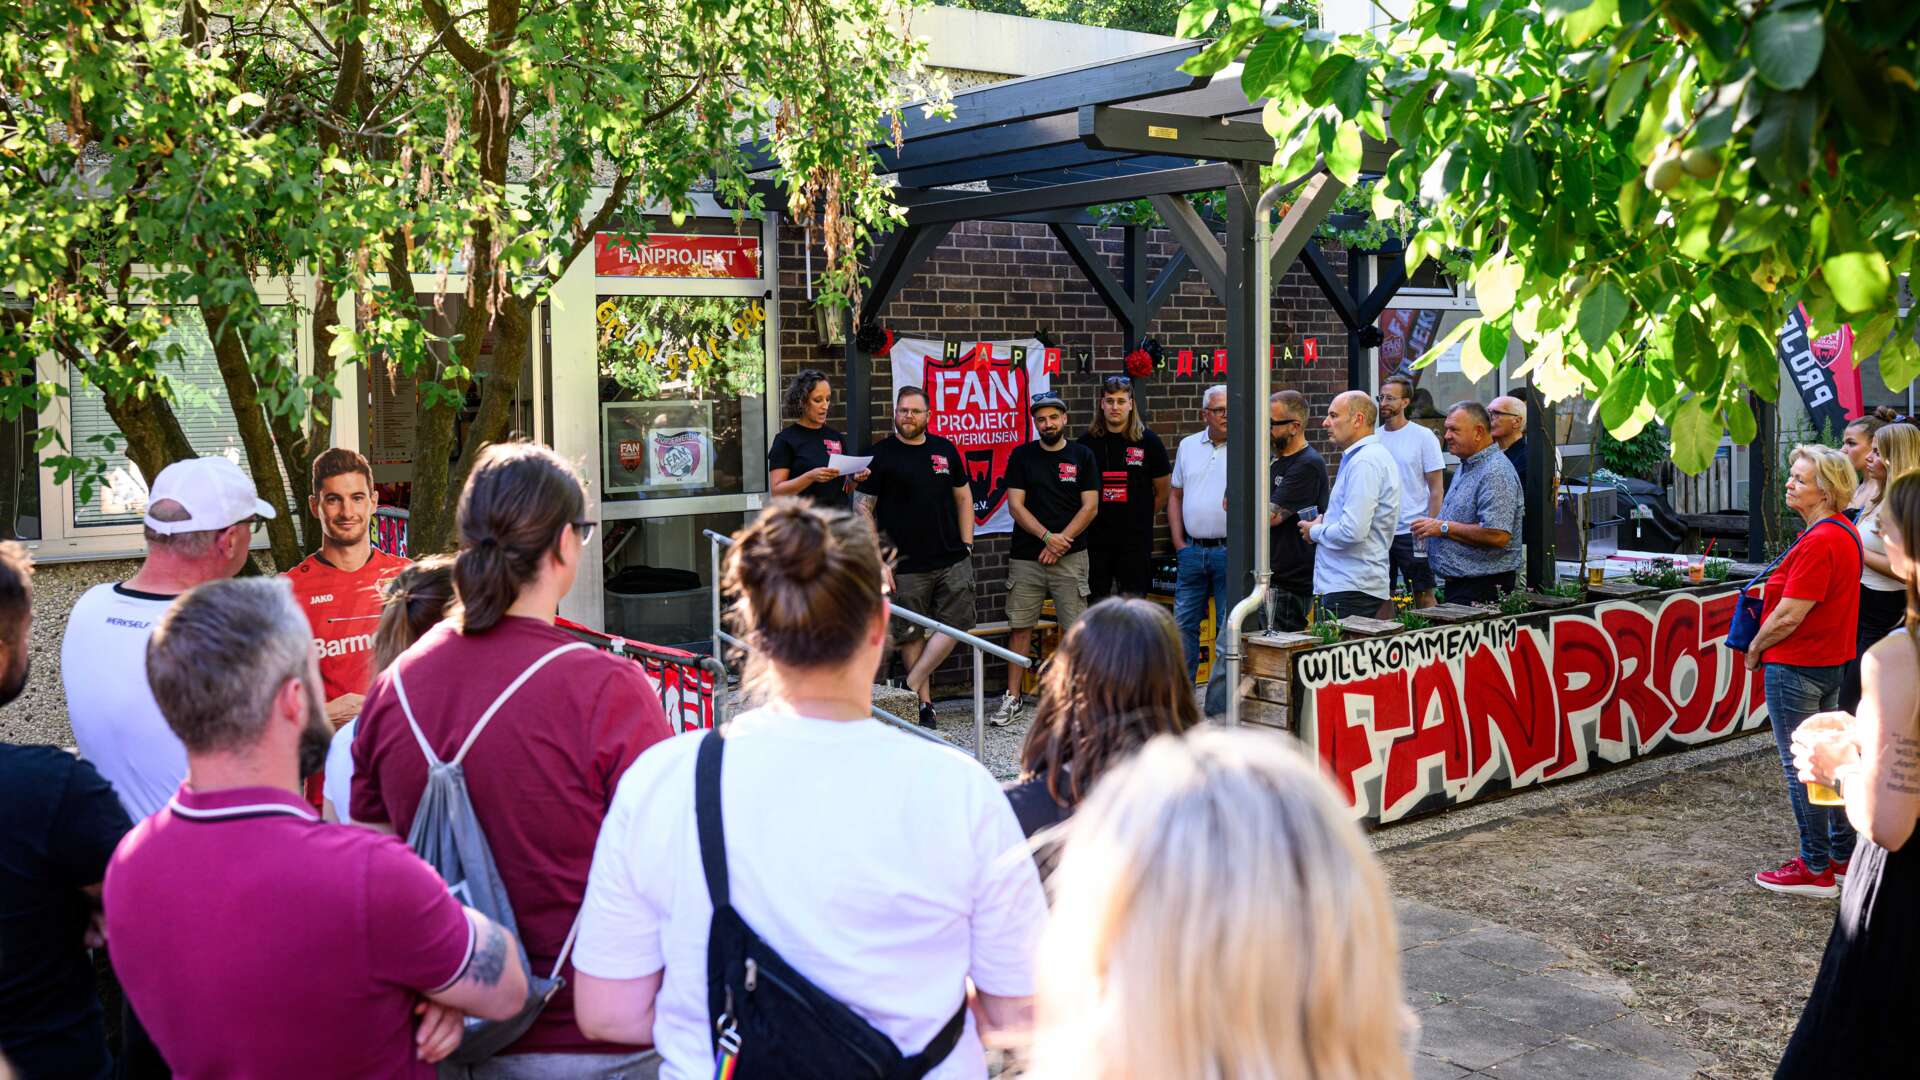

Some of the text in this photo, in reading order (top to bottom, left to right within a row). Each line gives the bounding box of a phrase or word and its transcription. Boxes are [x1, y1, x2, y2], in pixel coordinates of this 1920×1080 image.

[618, 247, 737, 267] FANPROJEKT
[725, 300, 767, 341] 1996
[946, 342, 1089, 369] HAPPY
[935, 370, 1019, 412] FAN
[936, 411, 1019, 432] PROJEKT
[620, 443, 640, 453] FAN
[945, 430, 1019, 446] EVERKUSEN
[665, 446, 689, 467] FAN
[973, 500, 989, 510] e.V.
[310, 593, 334, 605] JAKO
[1303, 620, 1517, 683] WILLKOMMEN IM
[1313, 584, 1768, 822] FANPROJ
